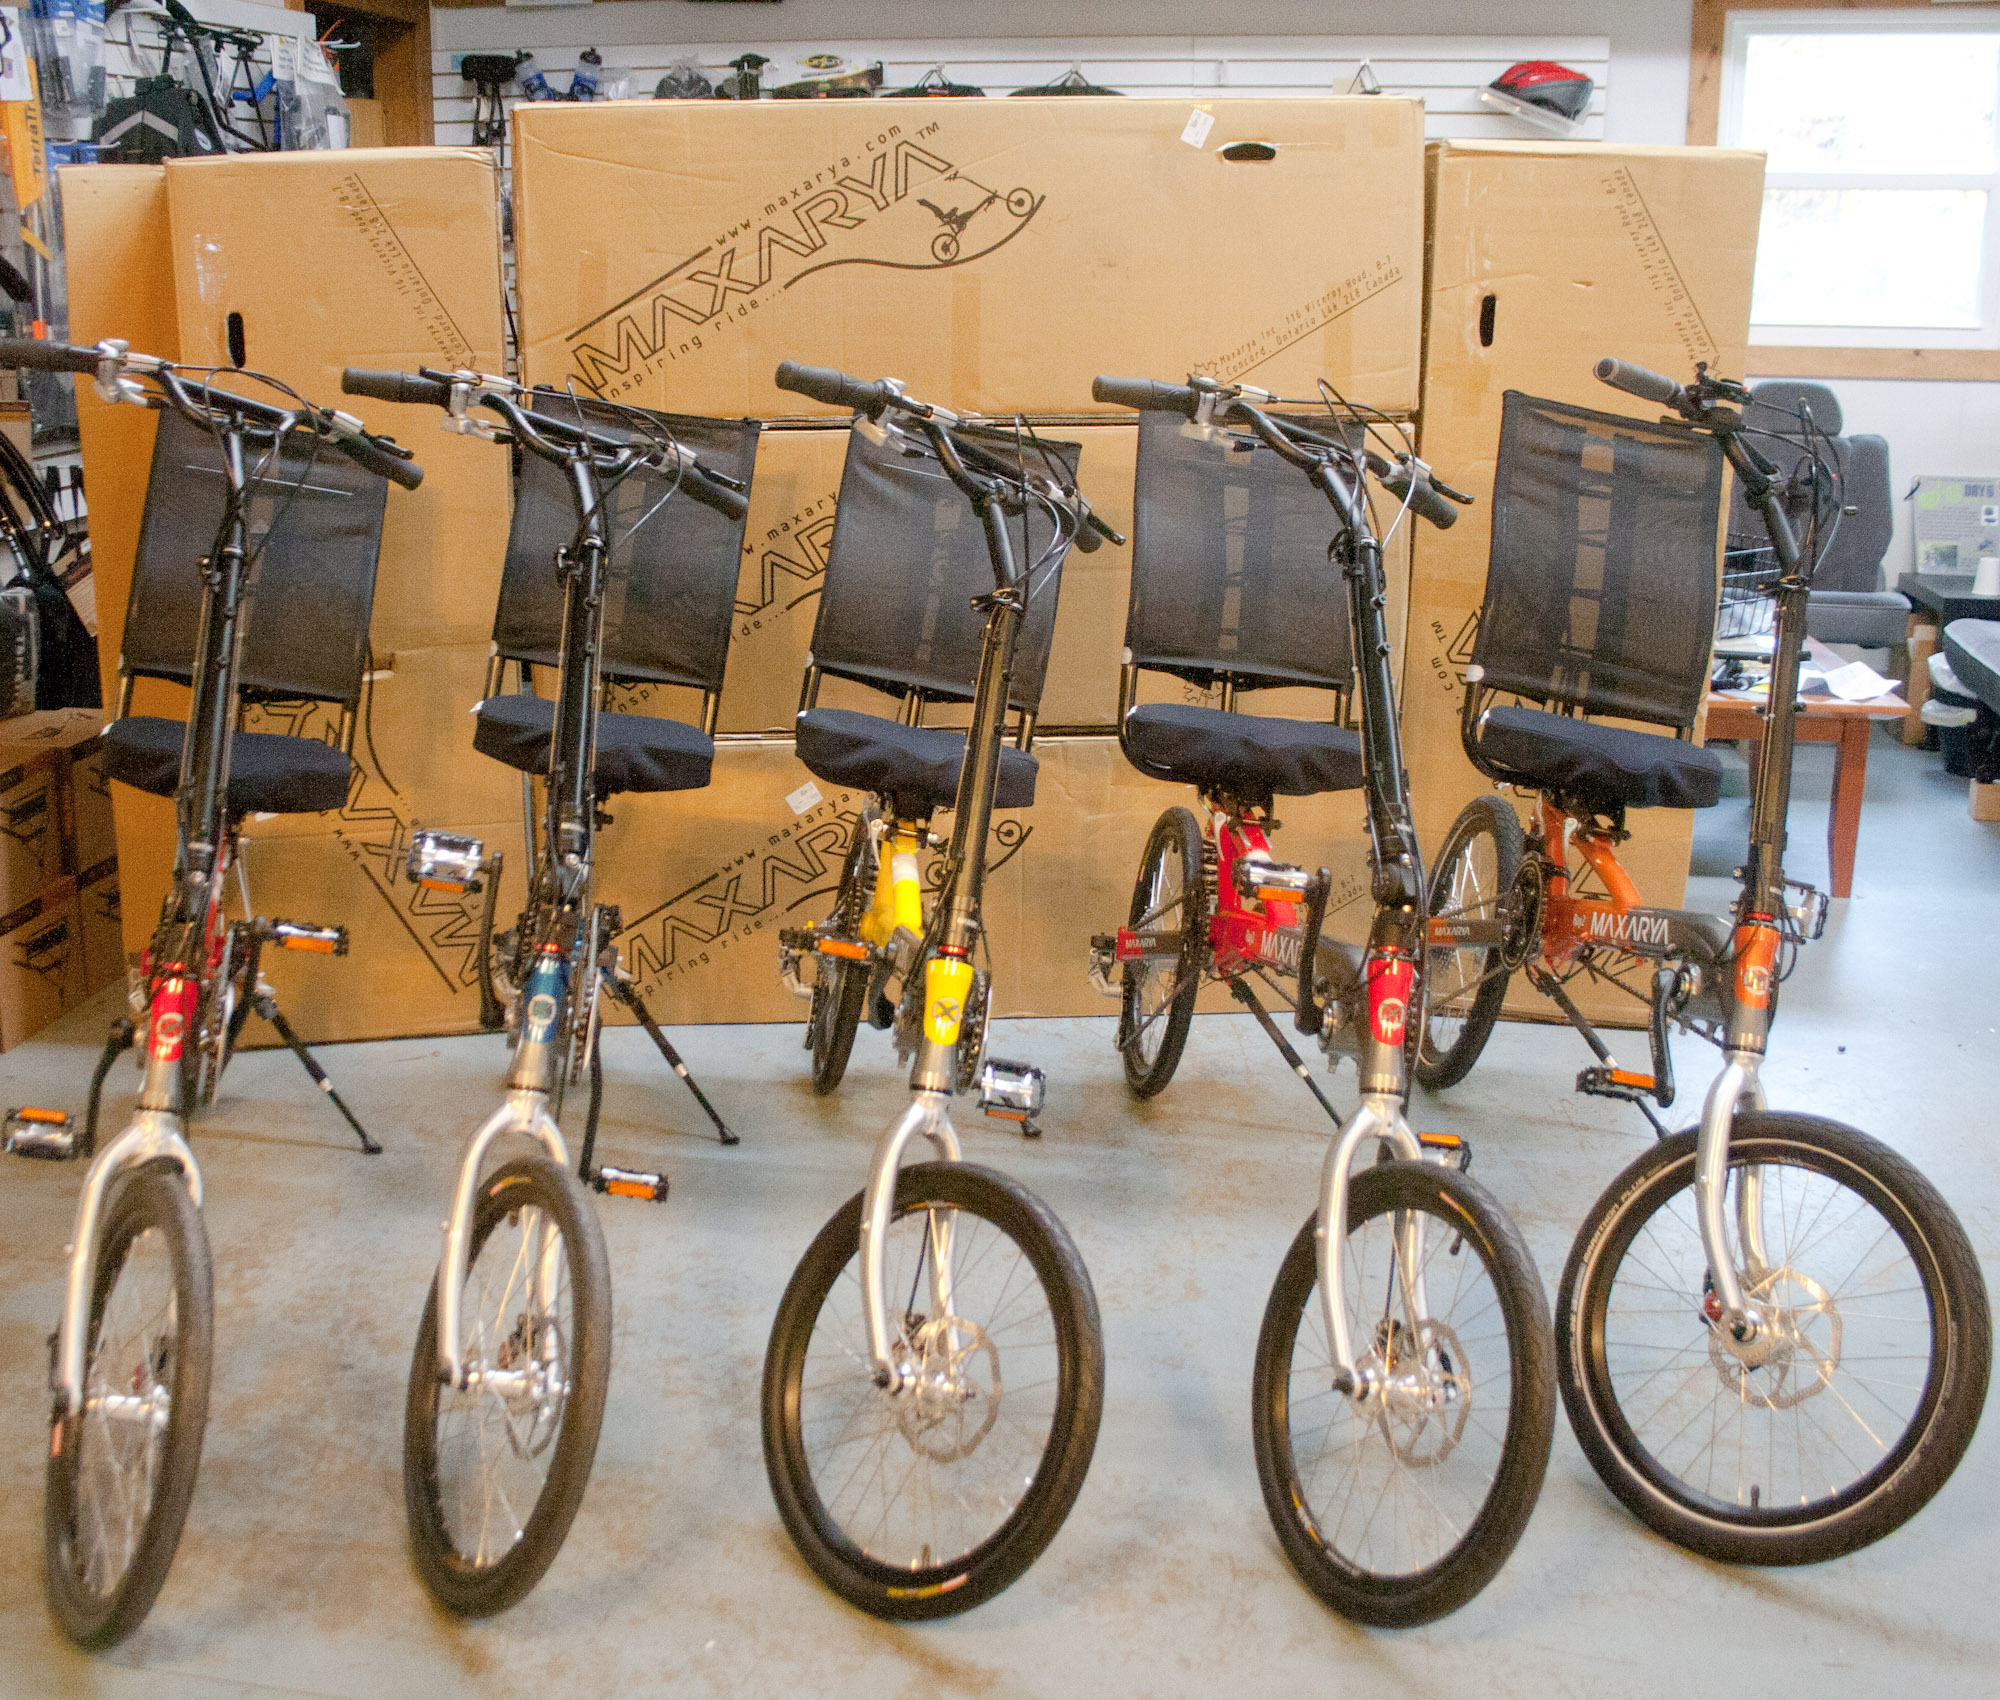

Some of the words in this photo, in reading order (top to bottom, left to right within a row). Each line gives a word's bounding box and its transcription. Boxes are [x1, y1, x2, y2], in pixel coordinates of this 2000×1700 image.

[25, 104, 42, 174] TerraTr
[714, 124, 903, 247] www.maxarya.com
[573, 140, 954, 391] MAXARYA
[1276, 317, 1317, 346] Ontario
[1366, 266, 1401, 291] Canada
[610, 333, 704, 398] nspiring
[1219, 339, 1256, 365] Maxarya
[722, 790, 861, 872] www.maxarya.
[1260, 930, 1301, 966] MAXA
[1434, 926, 1470, 936] MAXARYA
[1589, 911, 1669, 945] MAXARYA
